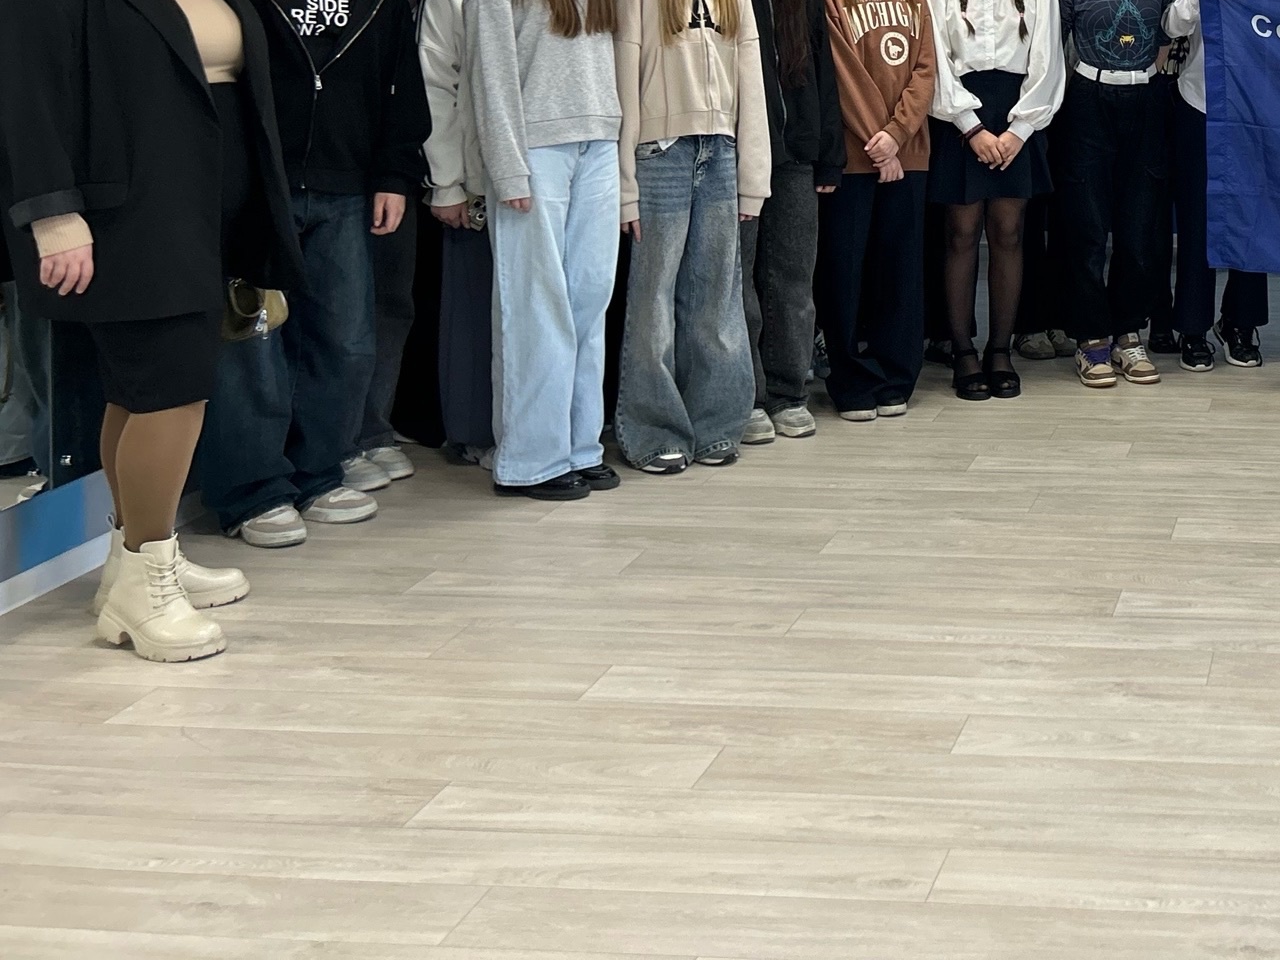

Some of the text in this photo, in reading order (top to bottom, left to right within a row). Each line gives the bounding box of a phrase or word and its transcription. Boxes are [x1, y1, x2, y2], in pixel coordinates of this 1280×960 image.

[291, 8, 352, 27] RE YO
[297, 23, 326, 36] N?
